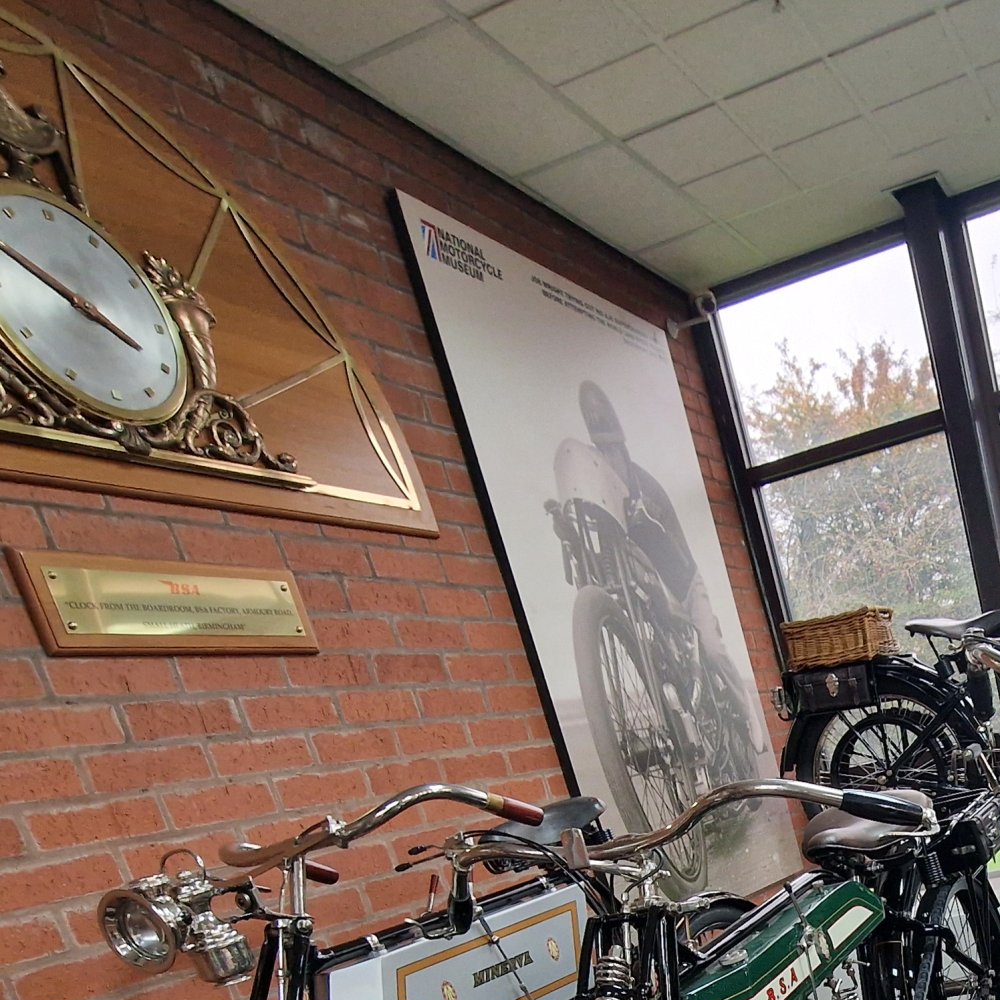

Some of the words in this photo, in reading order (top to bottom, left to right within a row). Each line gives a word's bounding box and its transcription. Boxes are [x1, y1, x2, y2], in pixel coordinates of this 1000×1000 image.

[437, 227, 485, 260] NATIONAL
[439, 239, 503, 280] MOTORCYCLE
[441, 252, 484, 282] MUSEUM
[169, 583, 200, 596] BSA
[98, 601, 125, 610] FROM
[123, 602, 142, 611] THE
[472, 951, 534, 988] MINERVA
